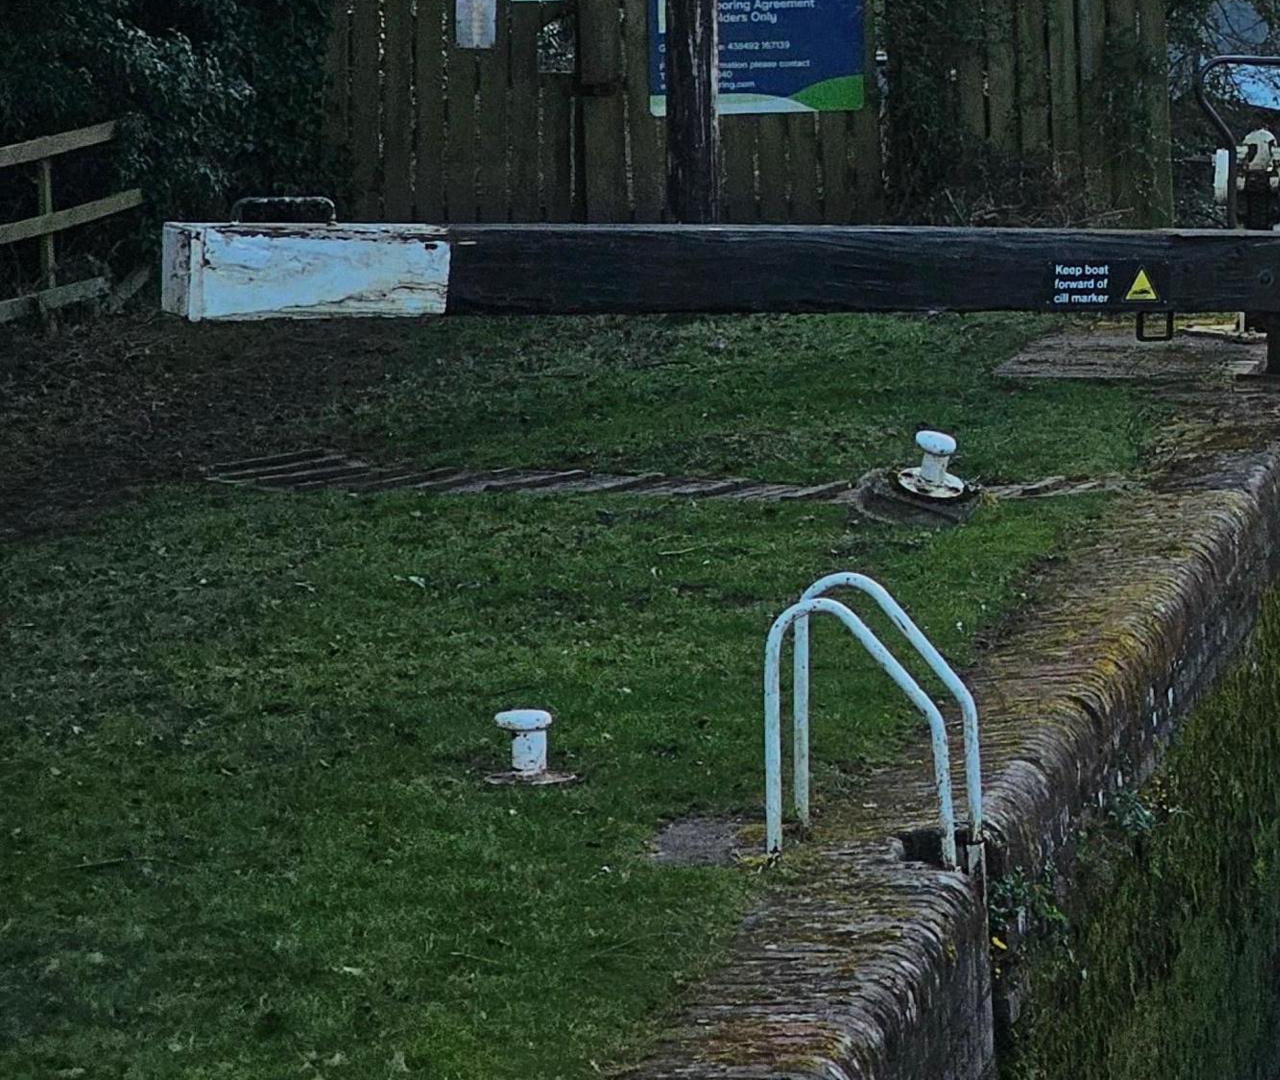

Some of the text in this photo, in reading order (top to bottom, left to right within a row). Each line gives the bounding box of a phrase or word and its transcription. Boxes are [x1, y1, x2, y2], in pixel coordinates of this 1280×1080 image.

[750, 10, 777, 24] Only
[1055, 264, 1109, 277] Keep boat
[1054, 278, 1108, 289] forward of
[1053, 293, 1109, 303] cill marker
